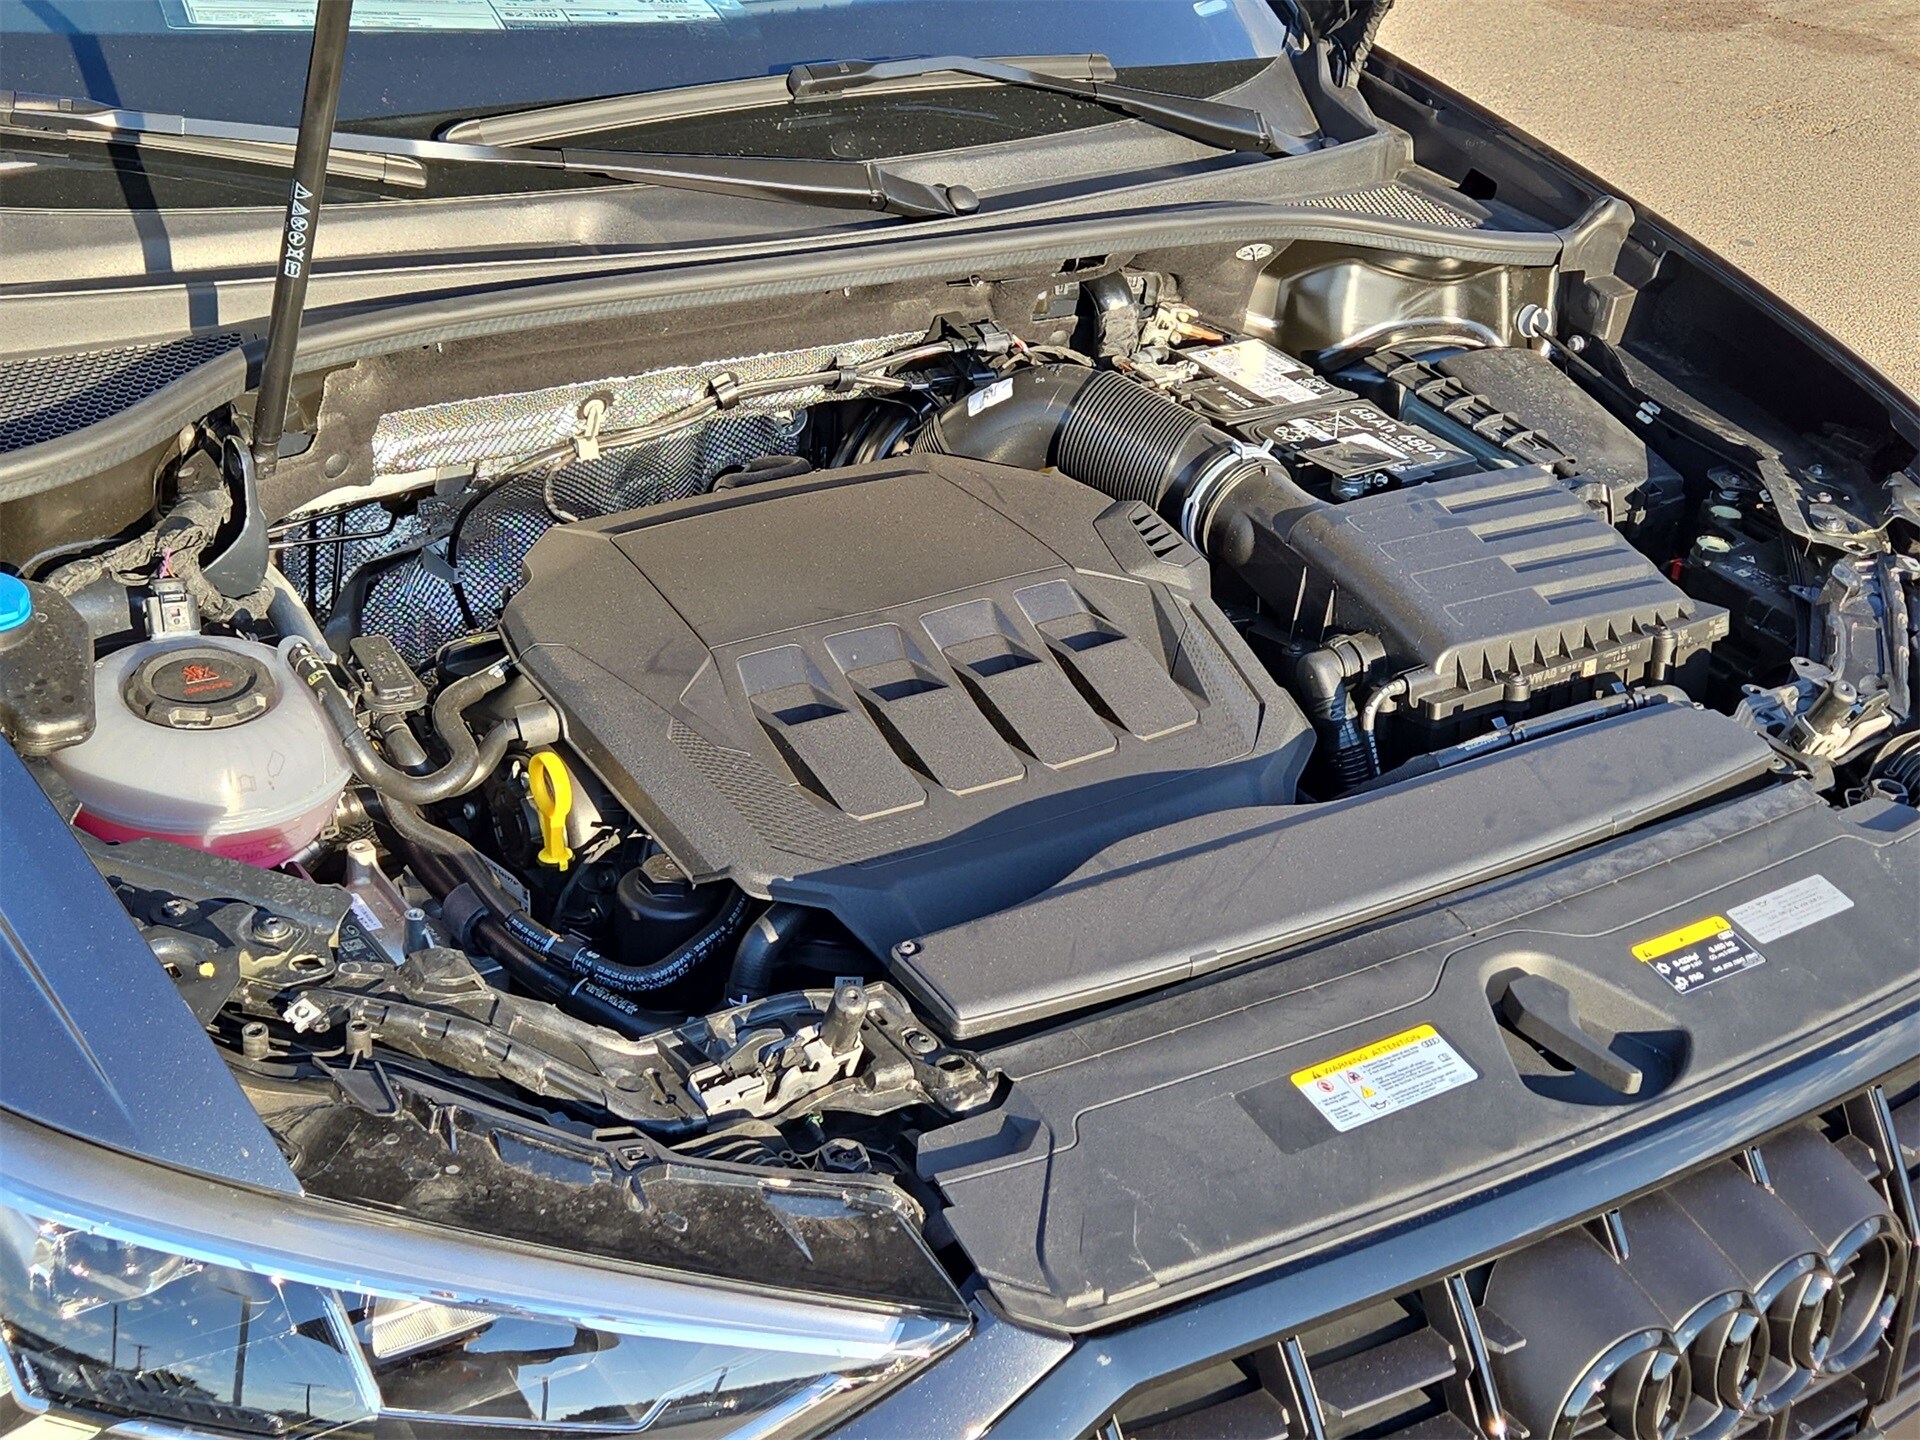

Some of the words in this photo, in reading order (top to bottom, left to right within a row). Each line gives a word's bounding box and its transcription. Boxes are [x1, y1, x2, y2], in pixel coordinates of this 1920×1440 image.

[1350, 408, 1398, 433] 68Ah
[1322, 1054, 1368, 1074] WARNING
[1372, 1035, 1421, 1056] ATTENTION
